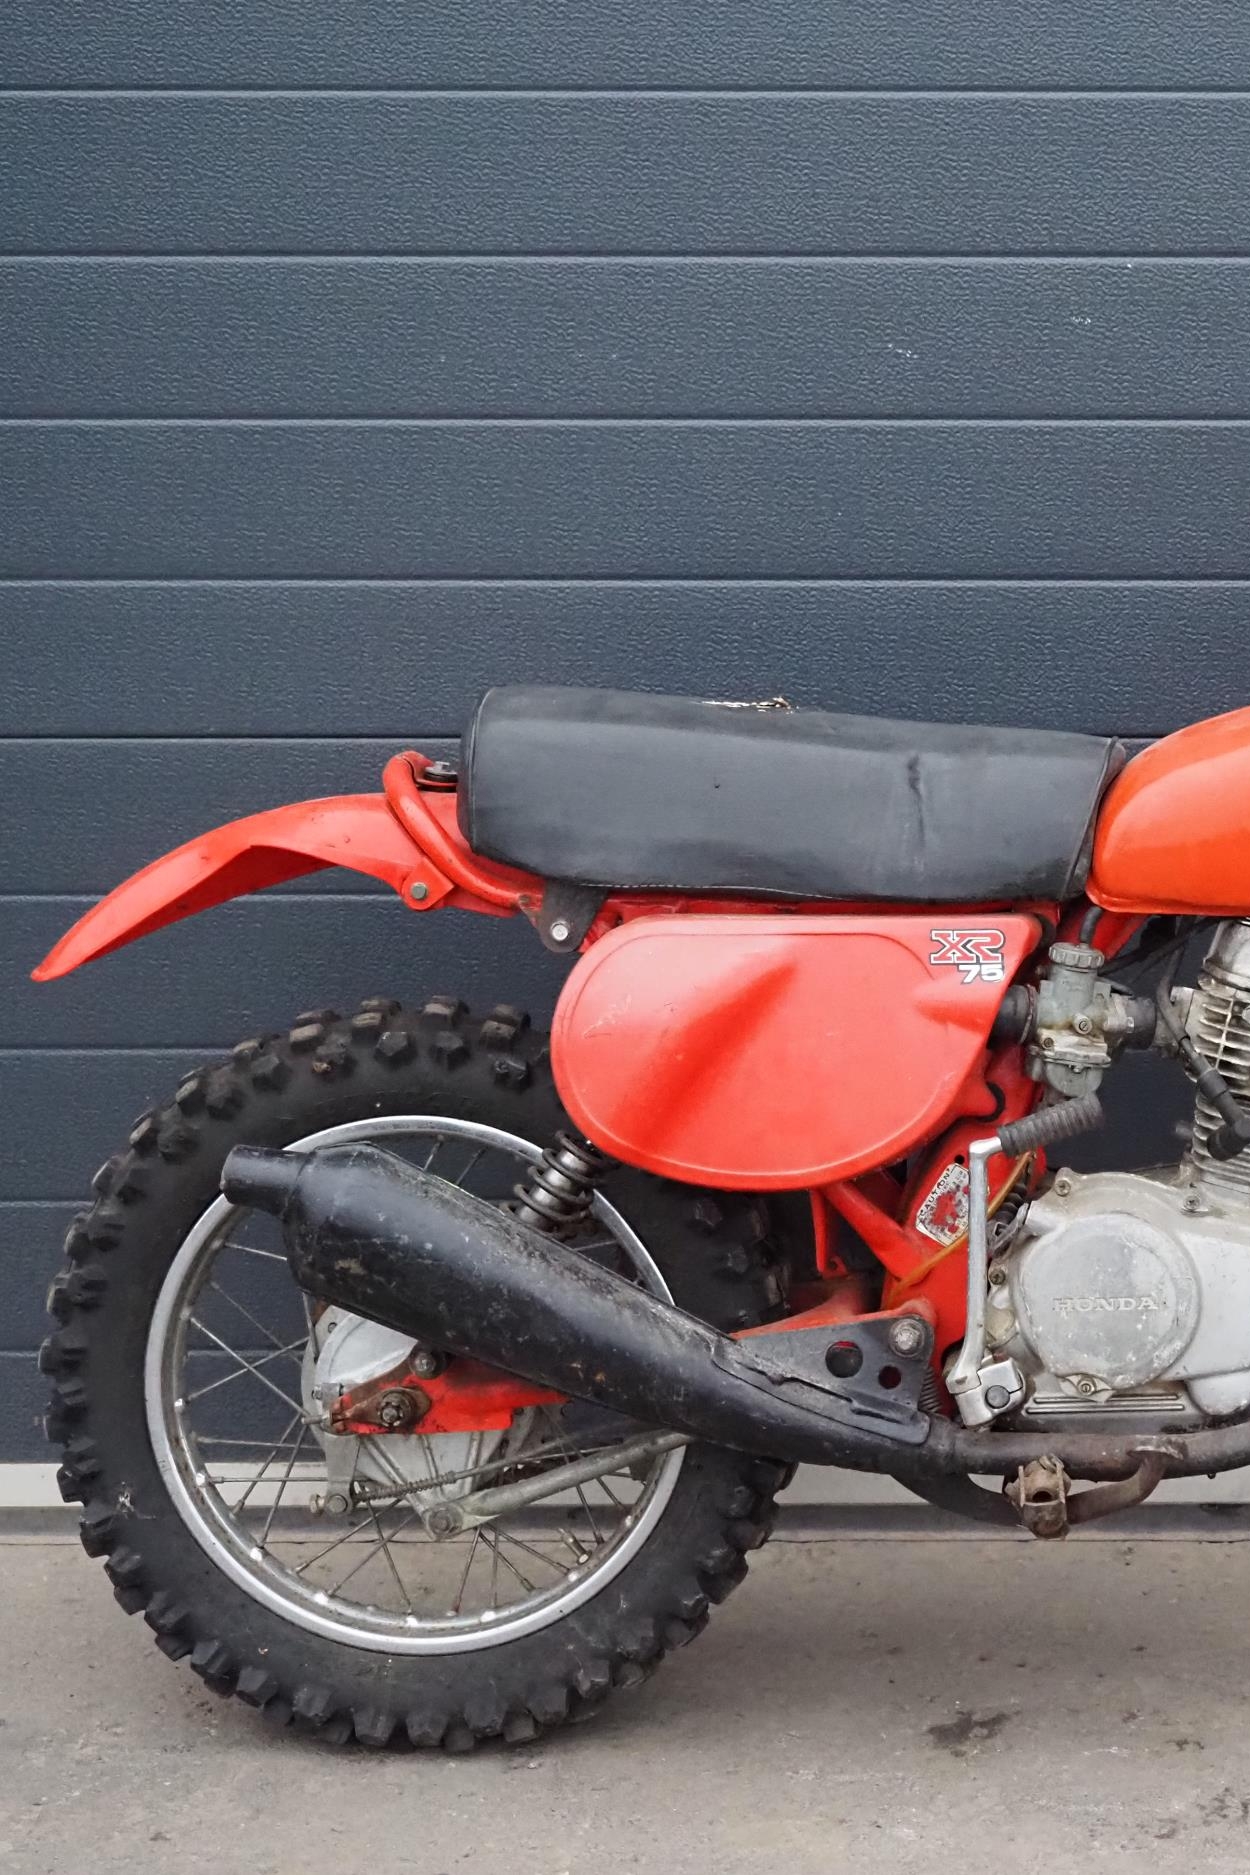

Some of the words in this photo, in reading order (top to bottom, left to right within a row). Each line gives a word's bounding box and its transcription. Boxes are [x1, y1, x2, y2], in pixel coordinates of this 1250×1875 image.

[930, 929, 1005, 964] XR
[957, 962, 1005, 984] 75
[1052, 1296, 1159, 1312] HONDA
